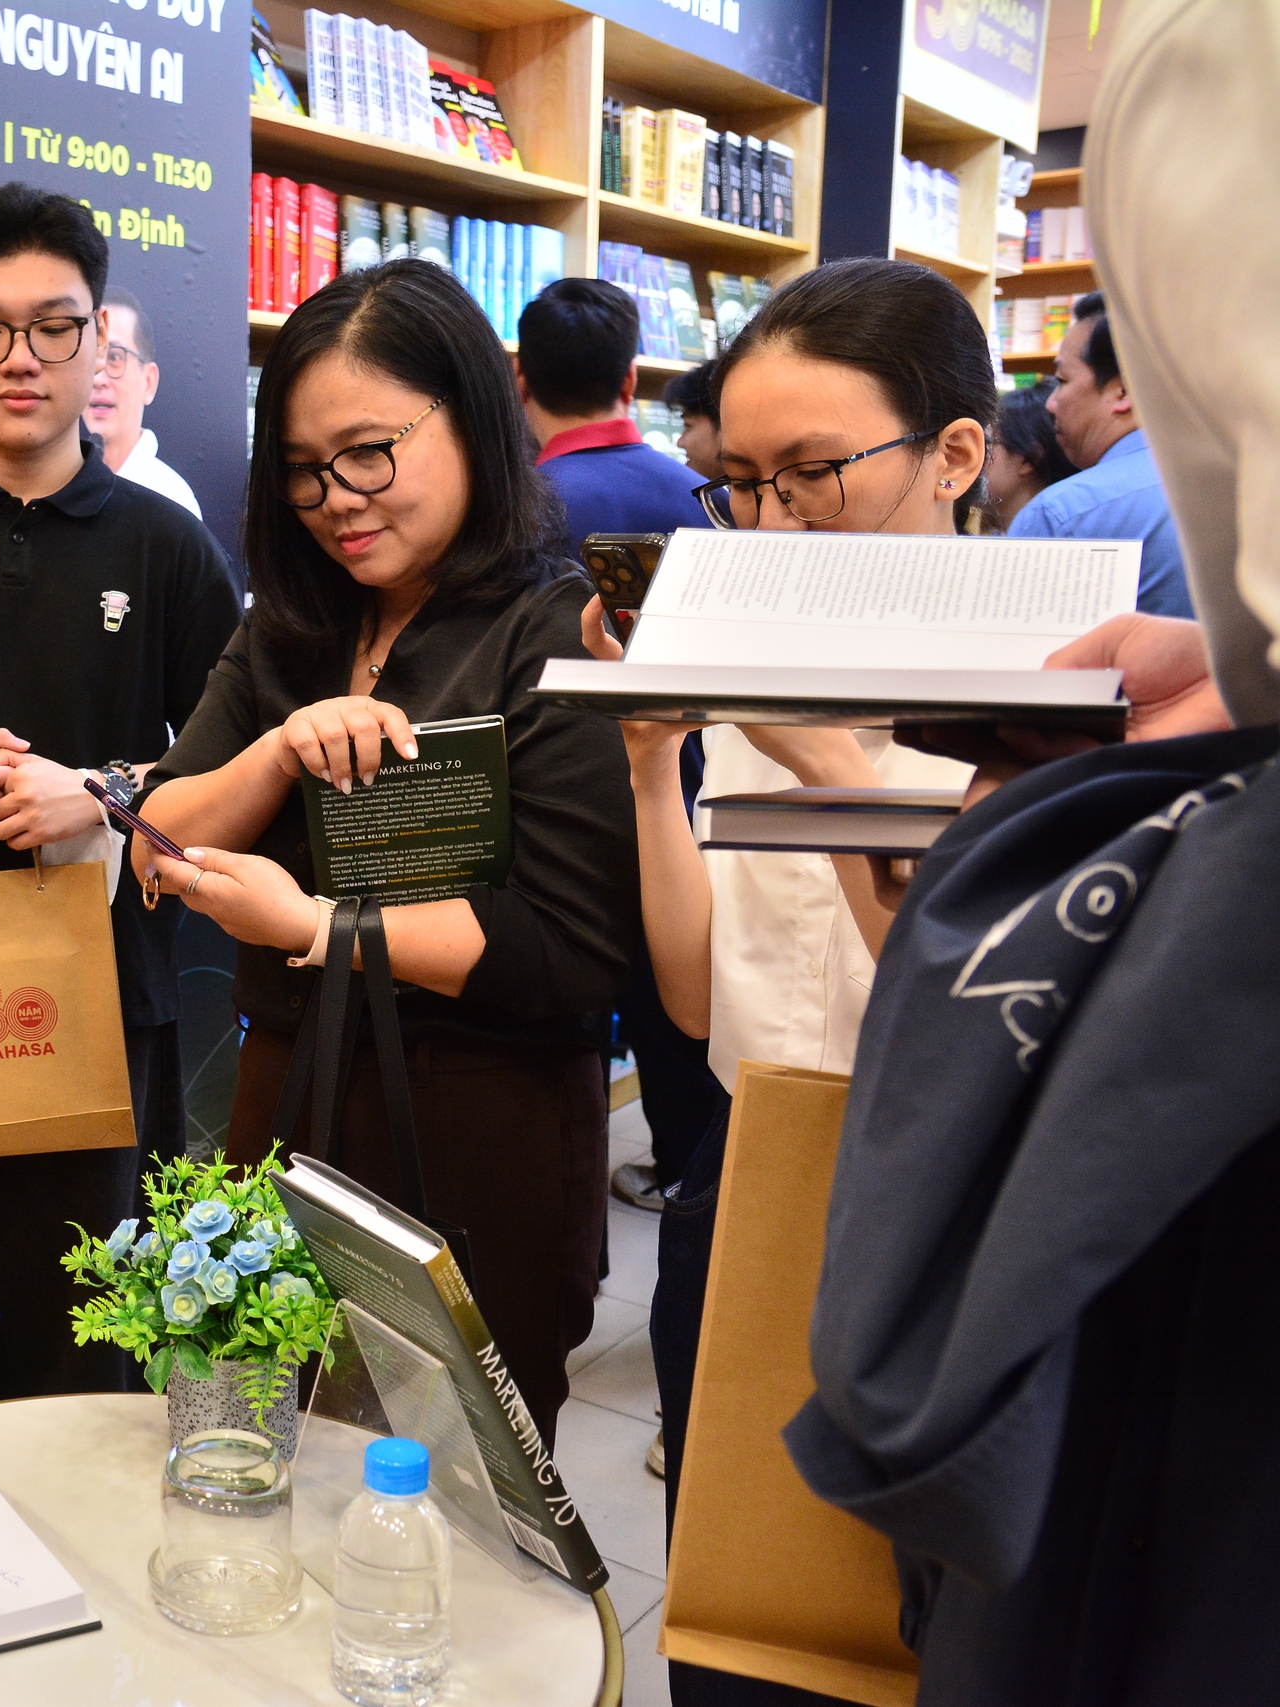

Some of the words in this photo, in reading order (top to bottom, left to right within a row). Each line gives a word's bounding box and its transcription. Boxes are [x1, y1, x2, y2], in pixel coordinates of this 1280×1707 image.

[150, 48, 183, 104] AI
[21, 126, 60, 164] Từ
[67, 136, 131, 176] 9:00
[152, 153, 213, 192] 11:30
[118, 206, 185, 251] Định
[379, 761, 442, 776] MARKETING
[445, 759, 462, 769] 7.0
[19, 1006, 41, 1017] NĂM
[436, 1272, 457, 1307] SETIAWAN
[449, 1257, 474, 1306] KOTLER
[476, 1341, 557, 1486] MARKETING
[545, 1494, 577, 1526] 7.0
